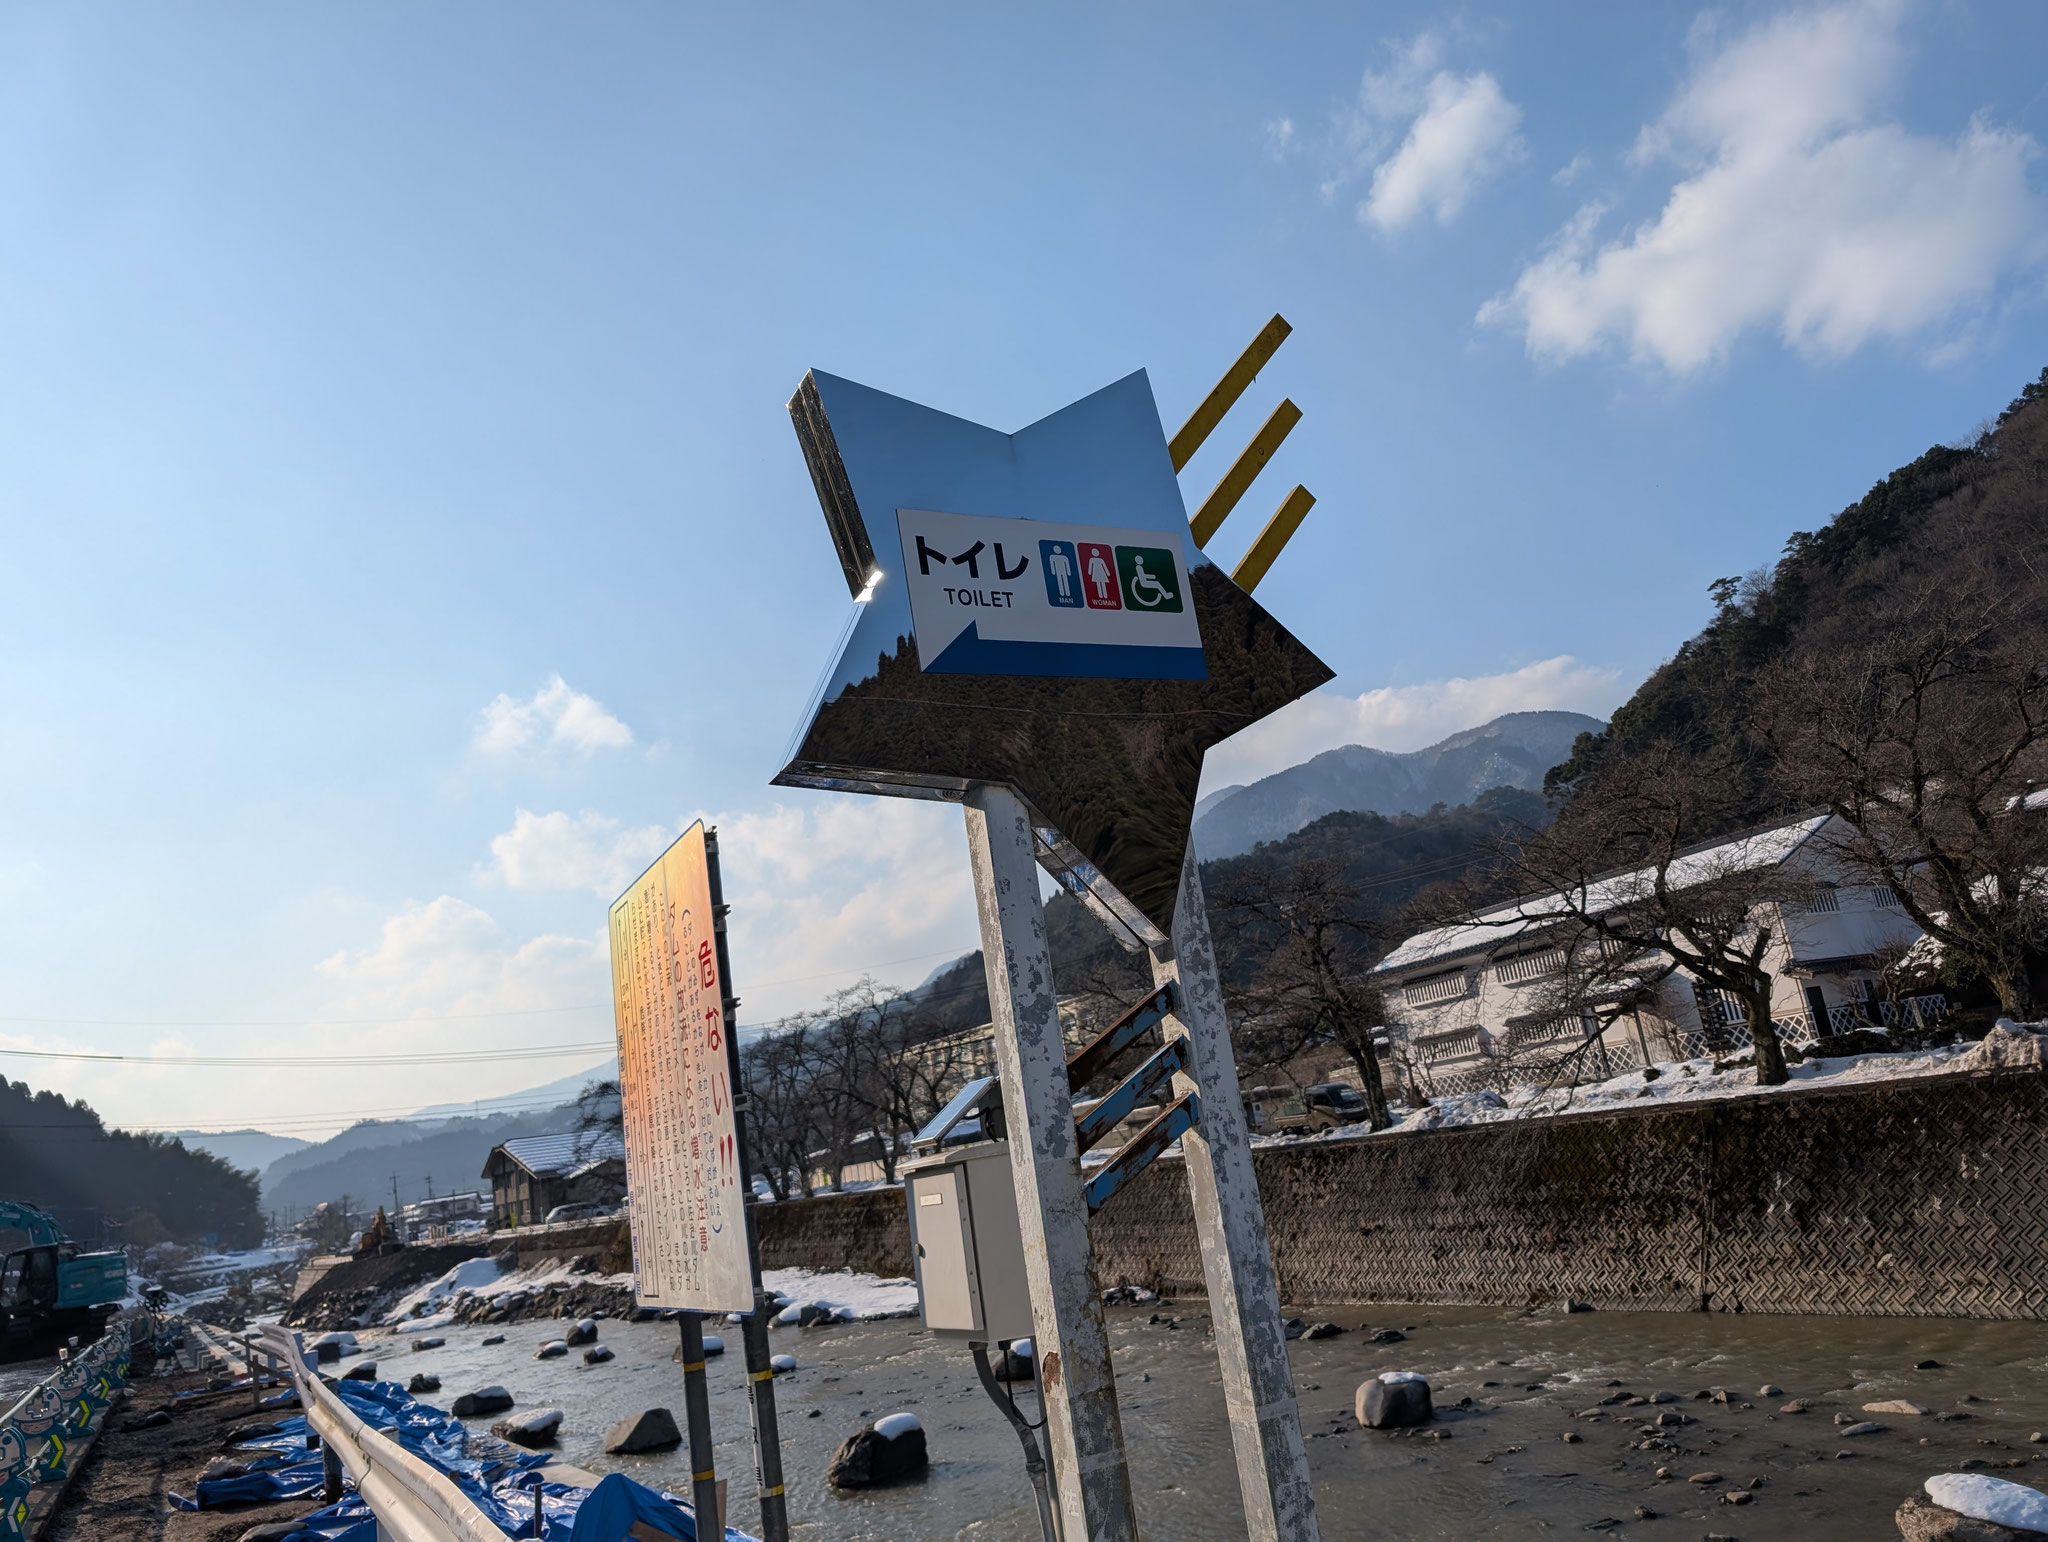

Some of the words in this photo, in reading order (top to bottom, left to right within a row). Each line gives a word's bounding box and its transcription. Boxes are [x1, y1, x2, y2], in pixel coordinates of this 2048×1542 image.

[915, 536, 1029, 580] トイレ
[943, 587, 1013, 608] TOILET
[1091, 599, 1117, 607] WOMAN
